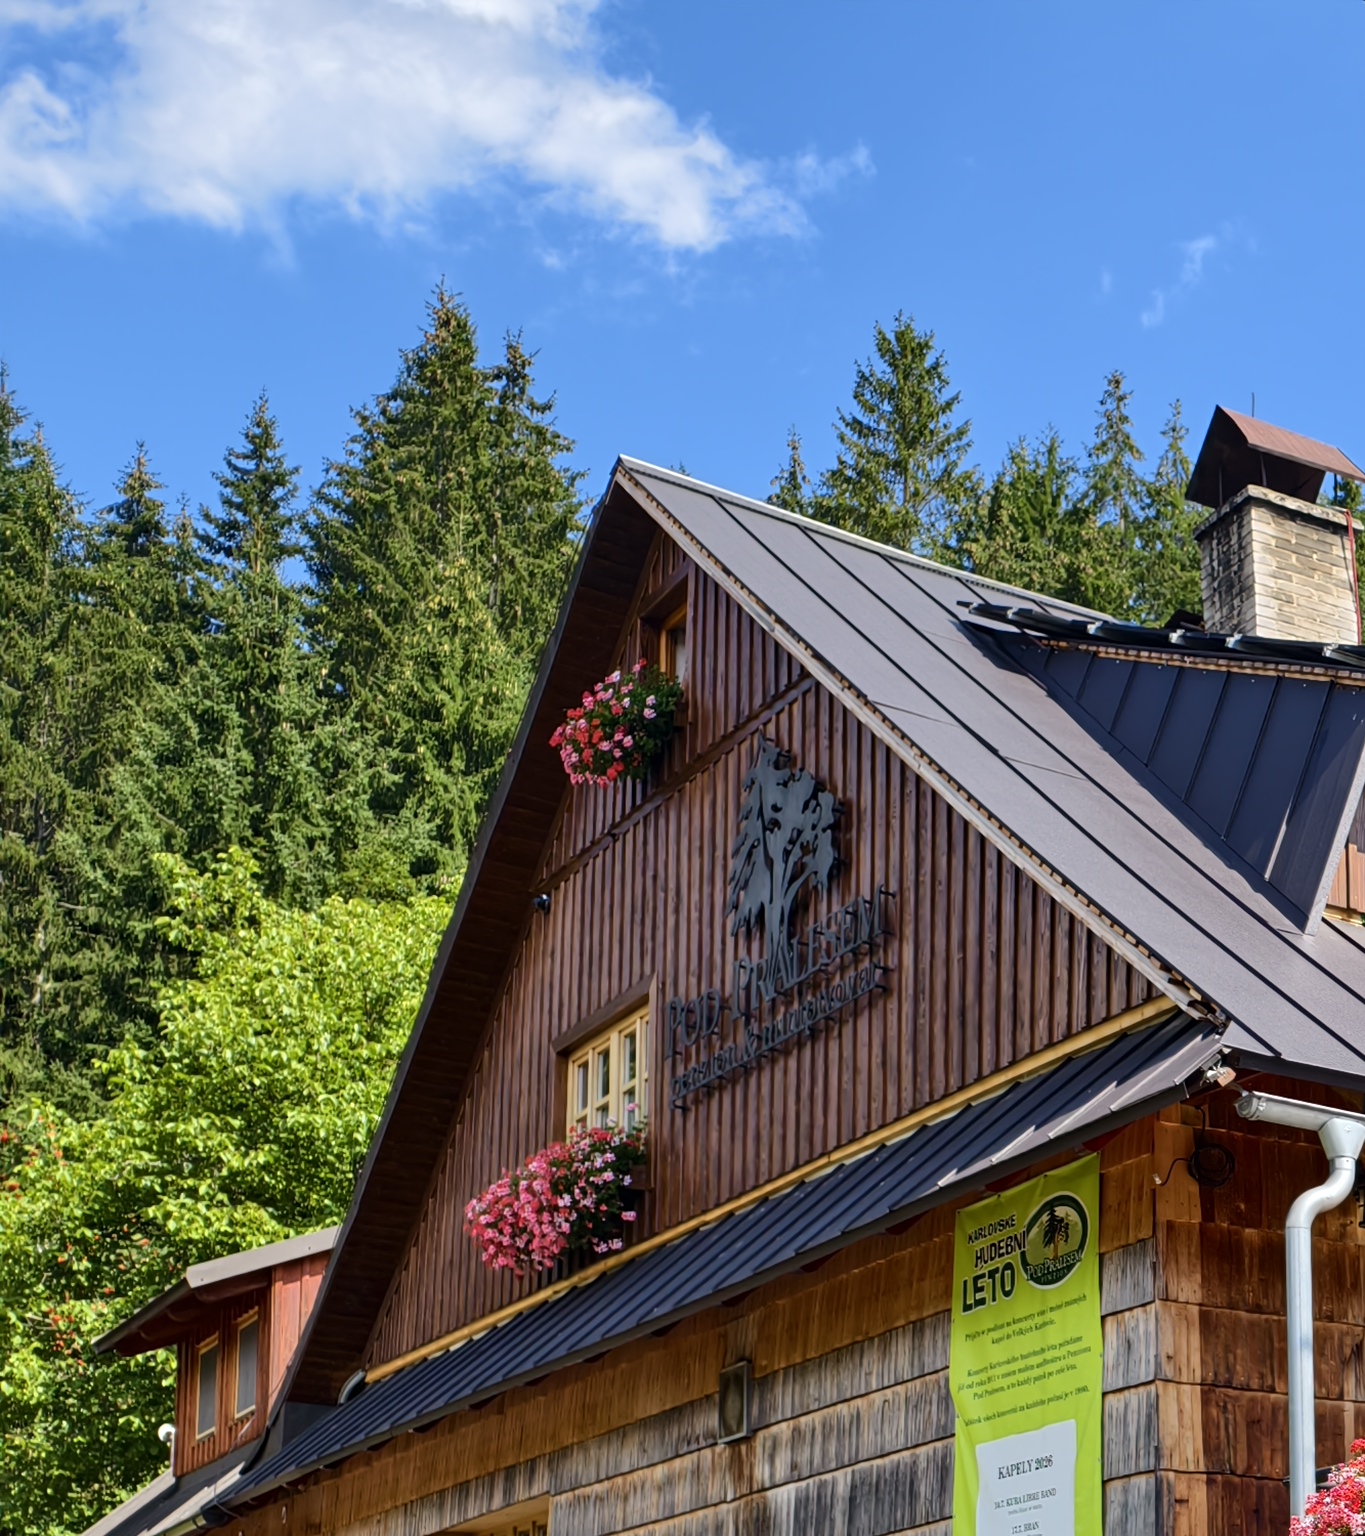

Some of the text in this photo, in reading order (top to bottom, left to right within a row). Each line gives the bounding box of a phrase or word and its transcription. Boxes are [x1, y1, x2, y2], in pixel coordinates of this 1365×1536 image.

[665, 883, 884, 1060] POD PRALESEM
[1027, 1250, 1082, 1280] POD PRALESEM
[962, 1262, 1016, 1314] LÉTO
[998, 1459, 1034, 1480] KAPELY
